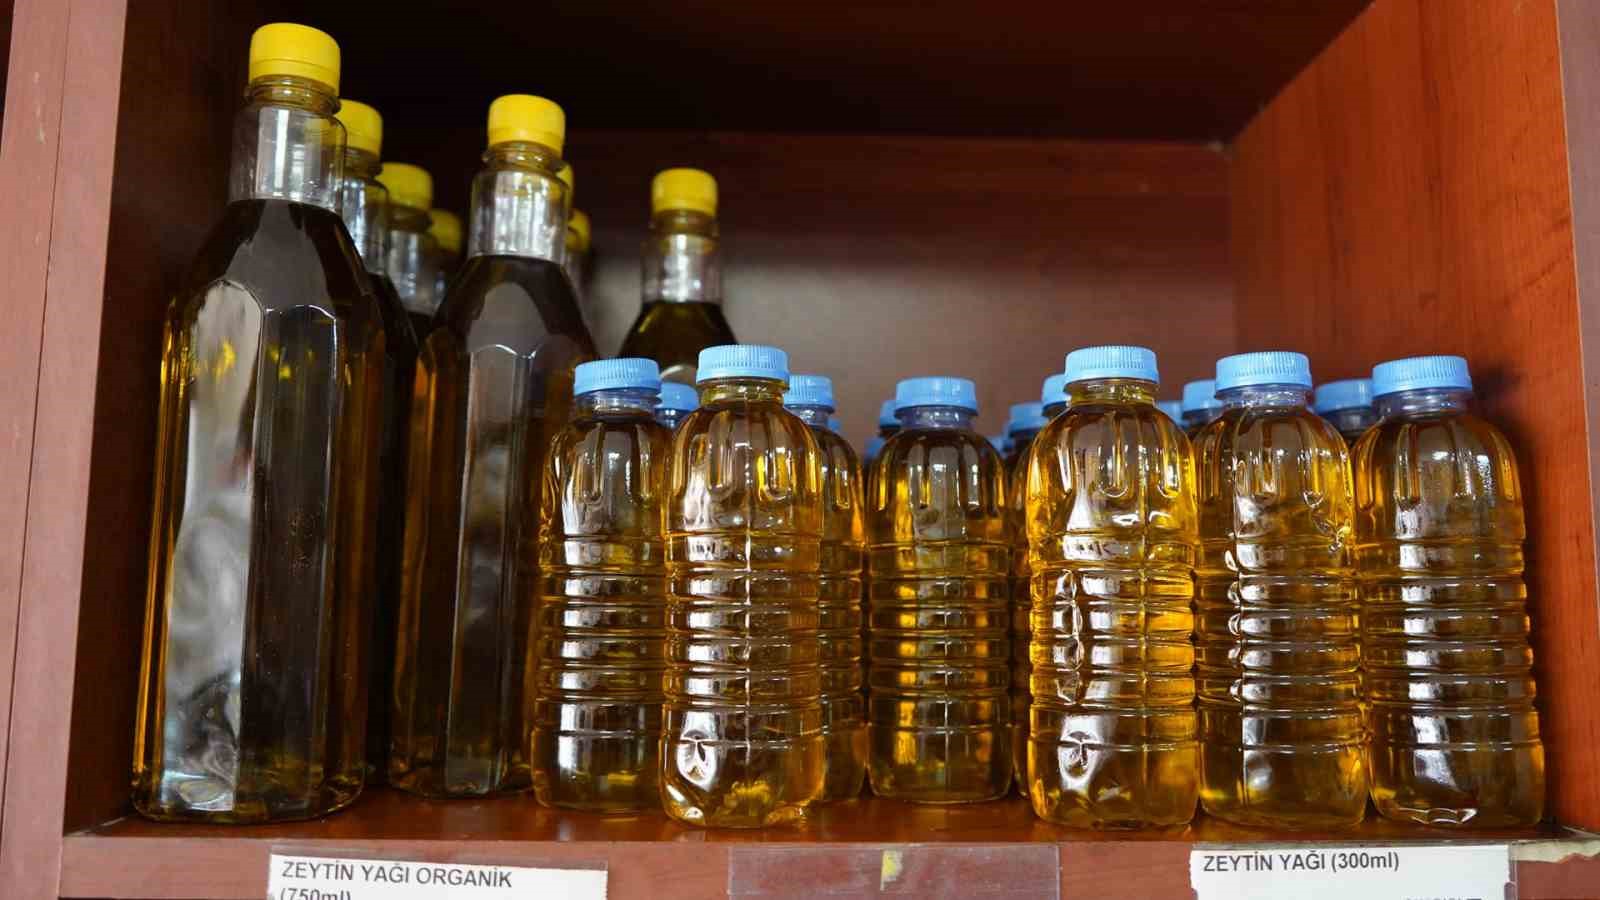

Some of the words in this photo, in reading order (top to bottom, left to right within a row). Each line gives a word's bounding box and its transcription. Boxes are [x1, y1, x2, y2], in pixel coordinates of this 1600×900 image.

[282, 860, 354, 881] ZEYTİN
[361, 863, 410, 884] YAĞI
[416, 867, 513, 888] ORGANİK
[1203, 851, 1273, 872] ZEYTİN
[1279, 850, 1325, 870] YAĞI
[1331, 851, 1400, 873] (300ml)
